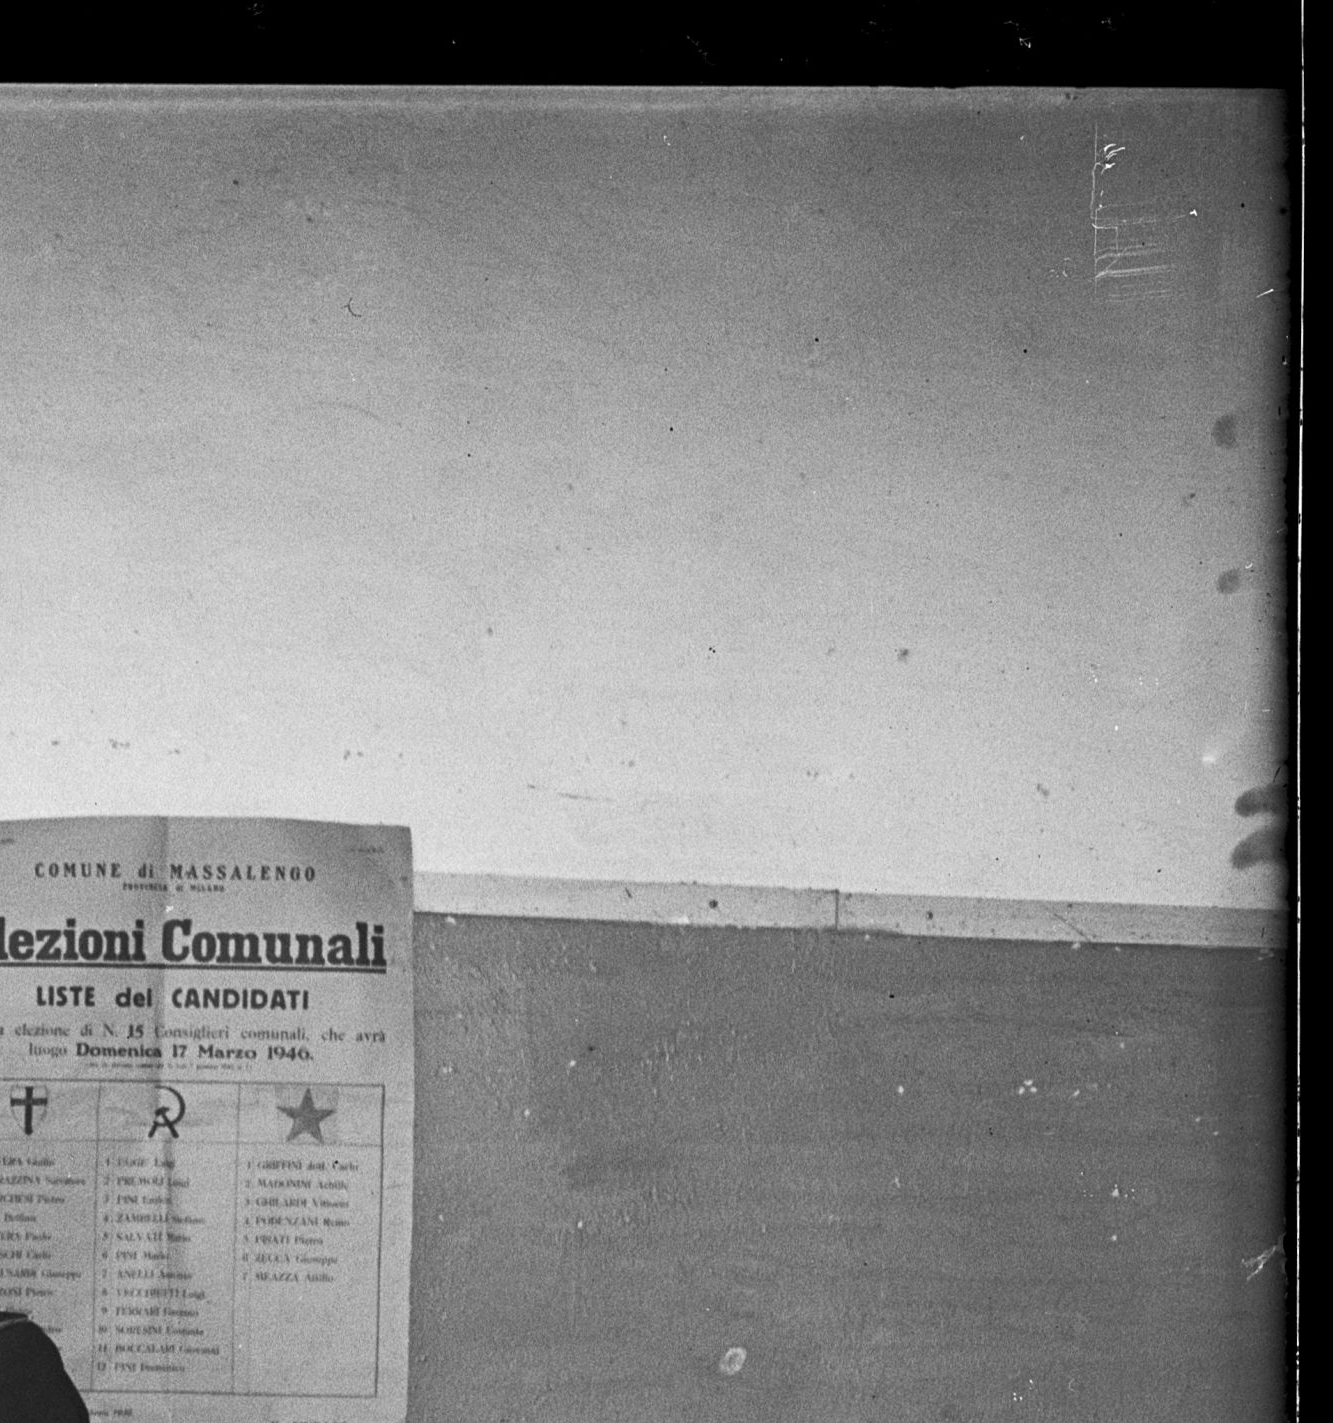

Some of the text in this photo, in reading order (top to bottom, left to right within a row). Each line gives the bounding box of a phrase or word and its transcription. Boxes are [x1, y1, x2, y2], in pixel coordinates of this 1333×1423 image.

[34, 862, 316, 882] COMUNE di MASSALENGO
[162, 917, 388, 968] Comunali
[36, 986, 96, 1007] LISTE
[171, 987, 310, 1010] CANDIDATI
[14, 1023, 71, 1037] elezione
[80, 1023, 93, 1037] di
[128, 1023, 144, 1039] 15
[154, 1025, 230, 1041] Consiglieri
[321, 1027, 346, 1042] che
[29, 1042, 68, 1058] luogo
[75, 1042, 163, 1058] Domenica
[172, 1044, 188, 1059] 17
[198, 1044, 258, 1060] Marzo
